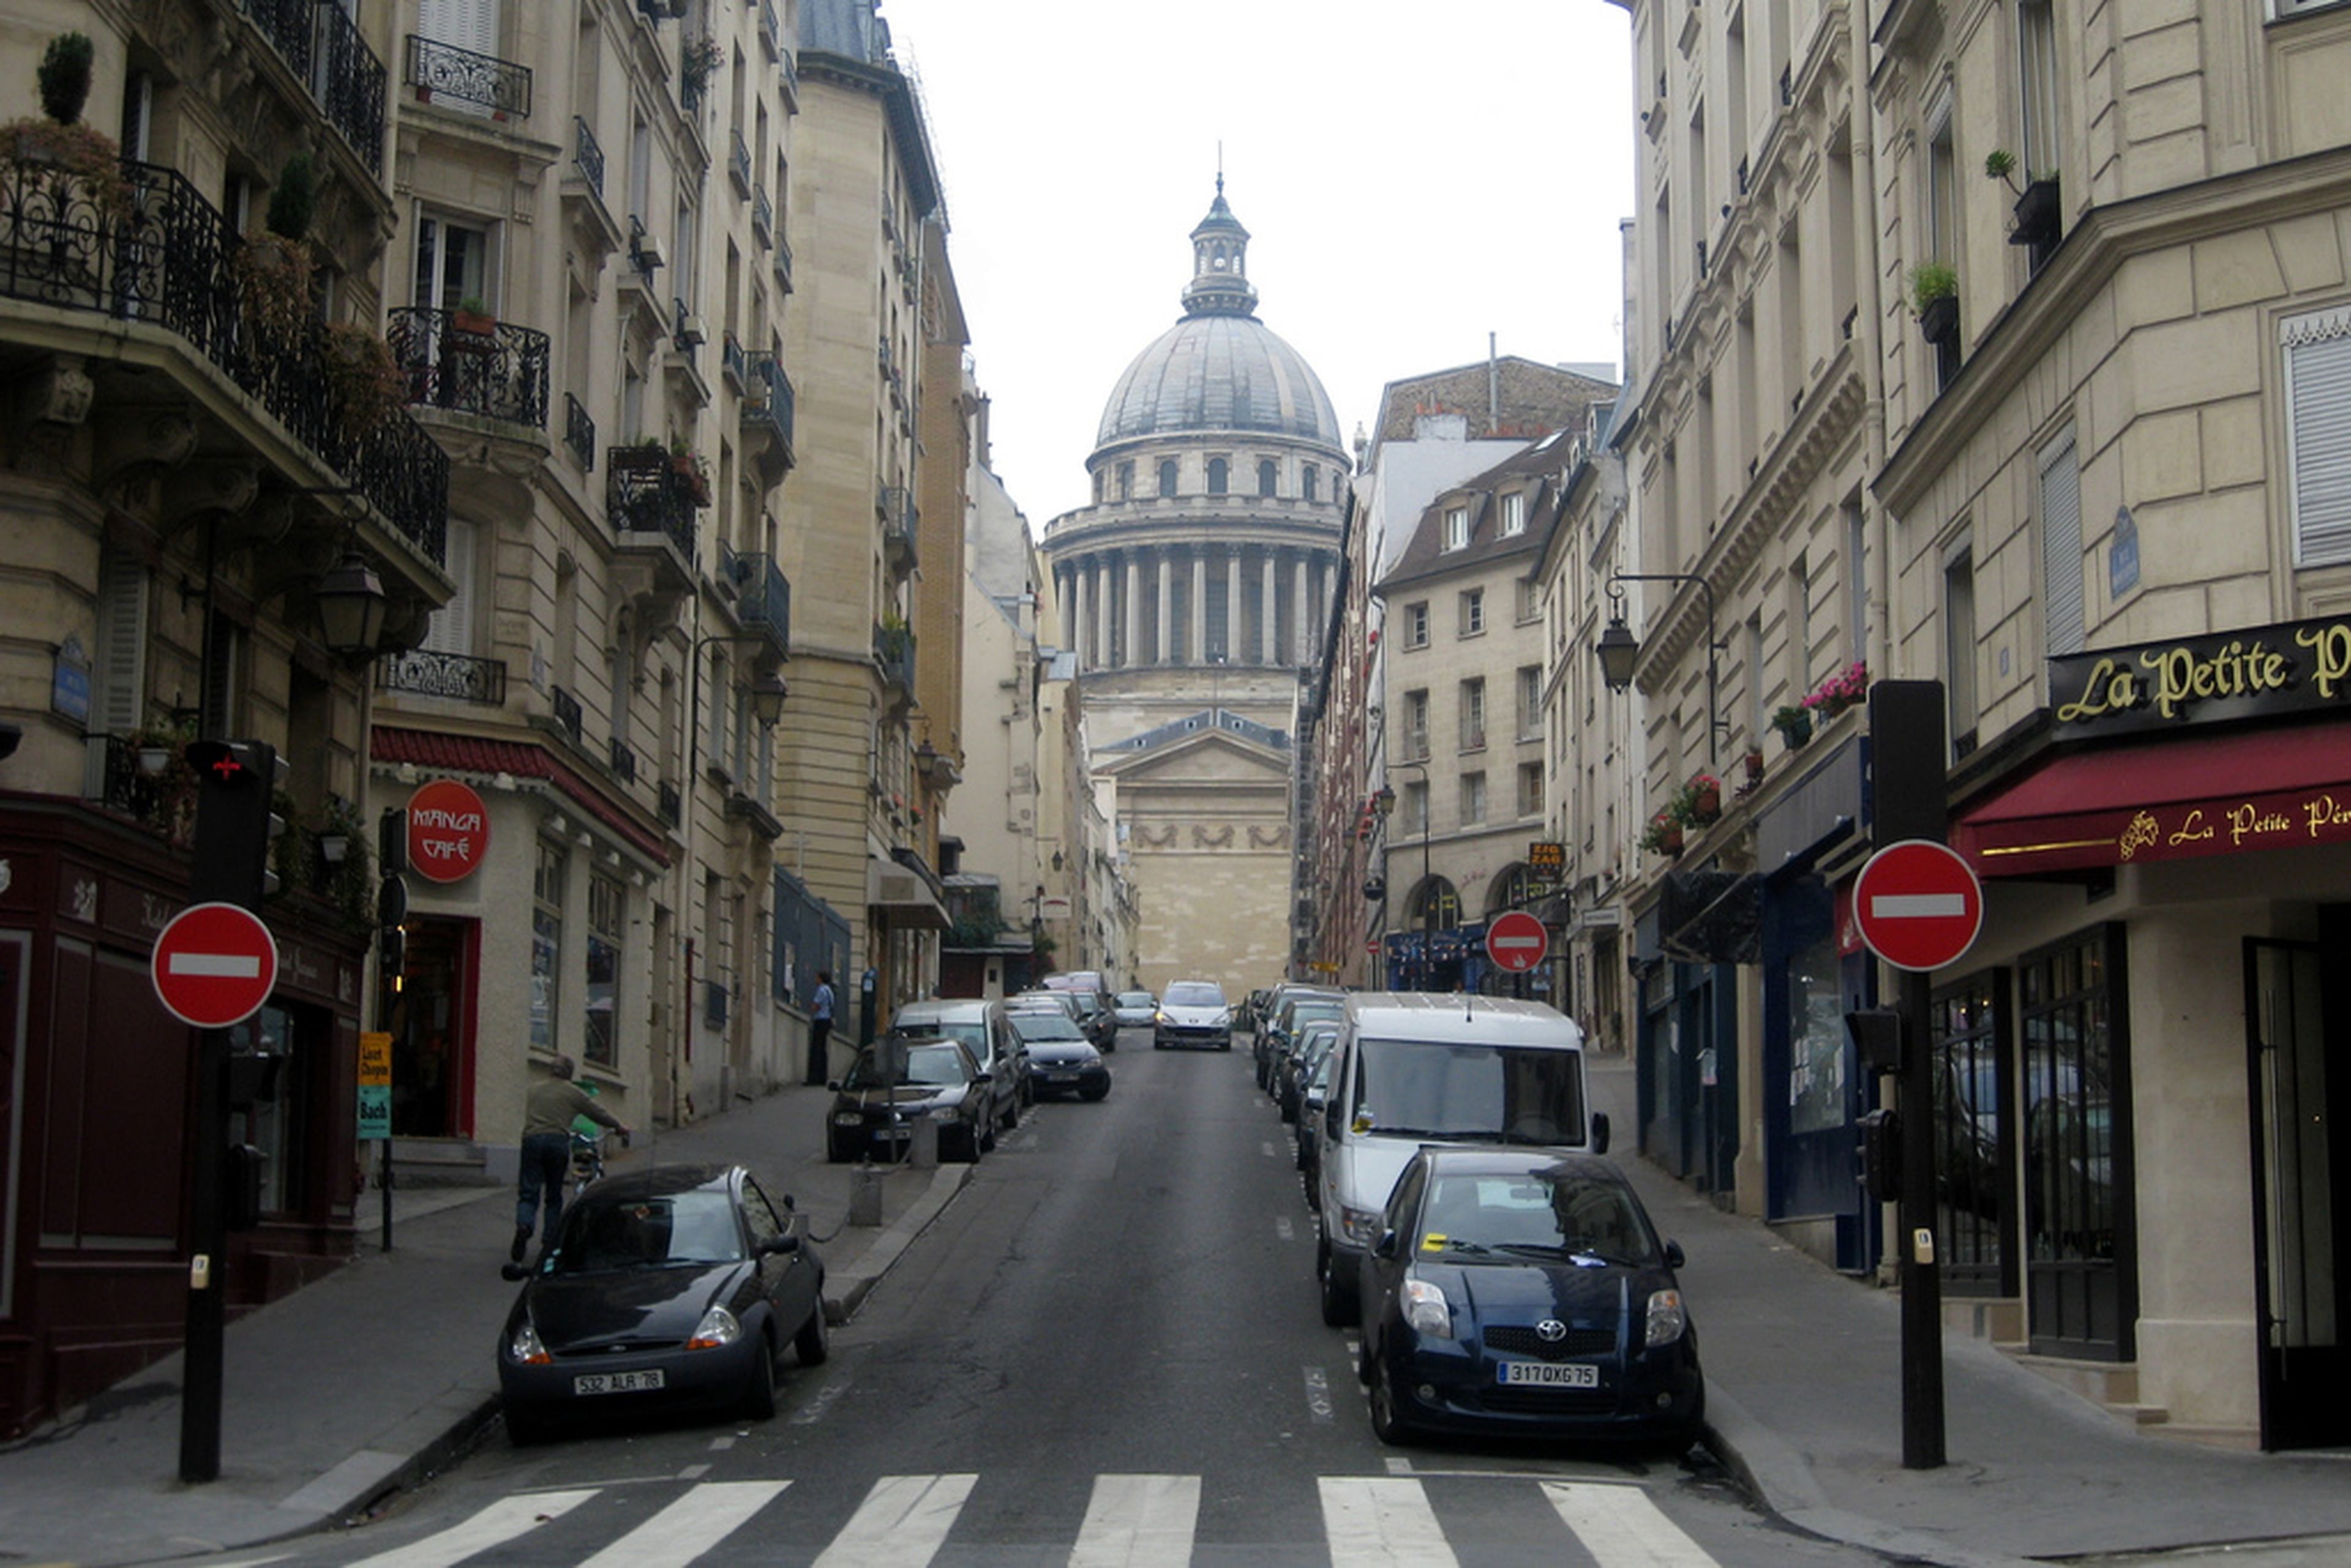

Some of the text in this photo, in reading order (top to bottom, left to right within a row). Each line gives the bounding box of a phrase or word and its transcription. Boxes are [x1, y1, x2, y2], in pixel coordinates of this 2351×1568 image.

[2057, 658, 2137, 722] La
[2140, 640, 2286, 719] Petite
[413, 808, 481, 832] MANGA
[2168, 810, 2214, 846] La
[2226, 803, 2290, 846] Petite
[422, 836, 470, 862] CAFÉ
[1533, 844, 1559, 854] ZIG
[1531, 855, 1561, 865] ZAG
[360, 1101, 388, 1120] Bach
[1575, 1367, 1593, 1384] 75
